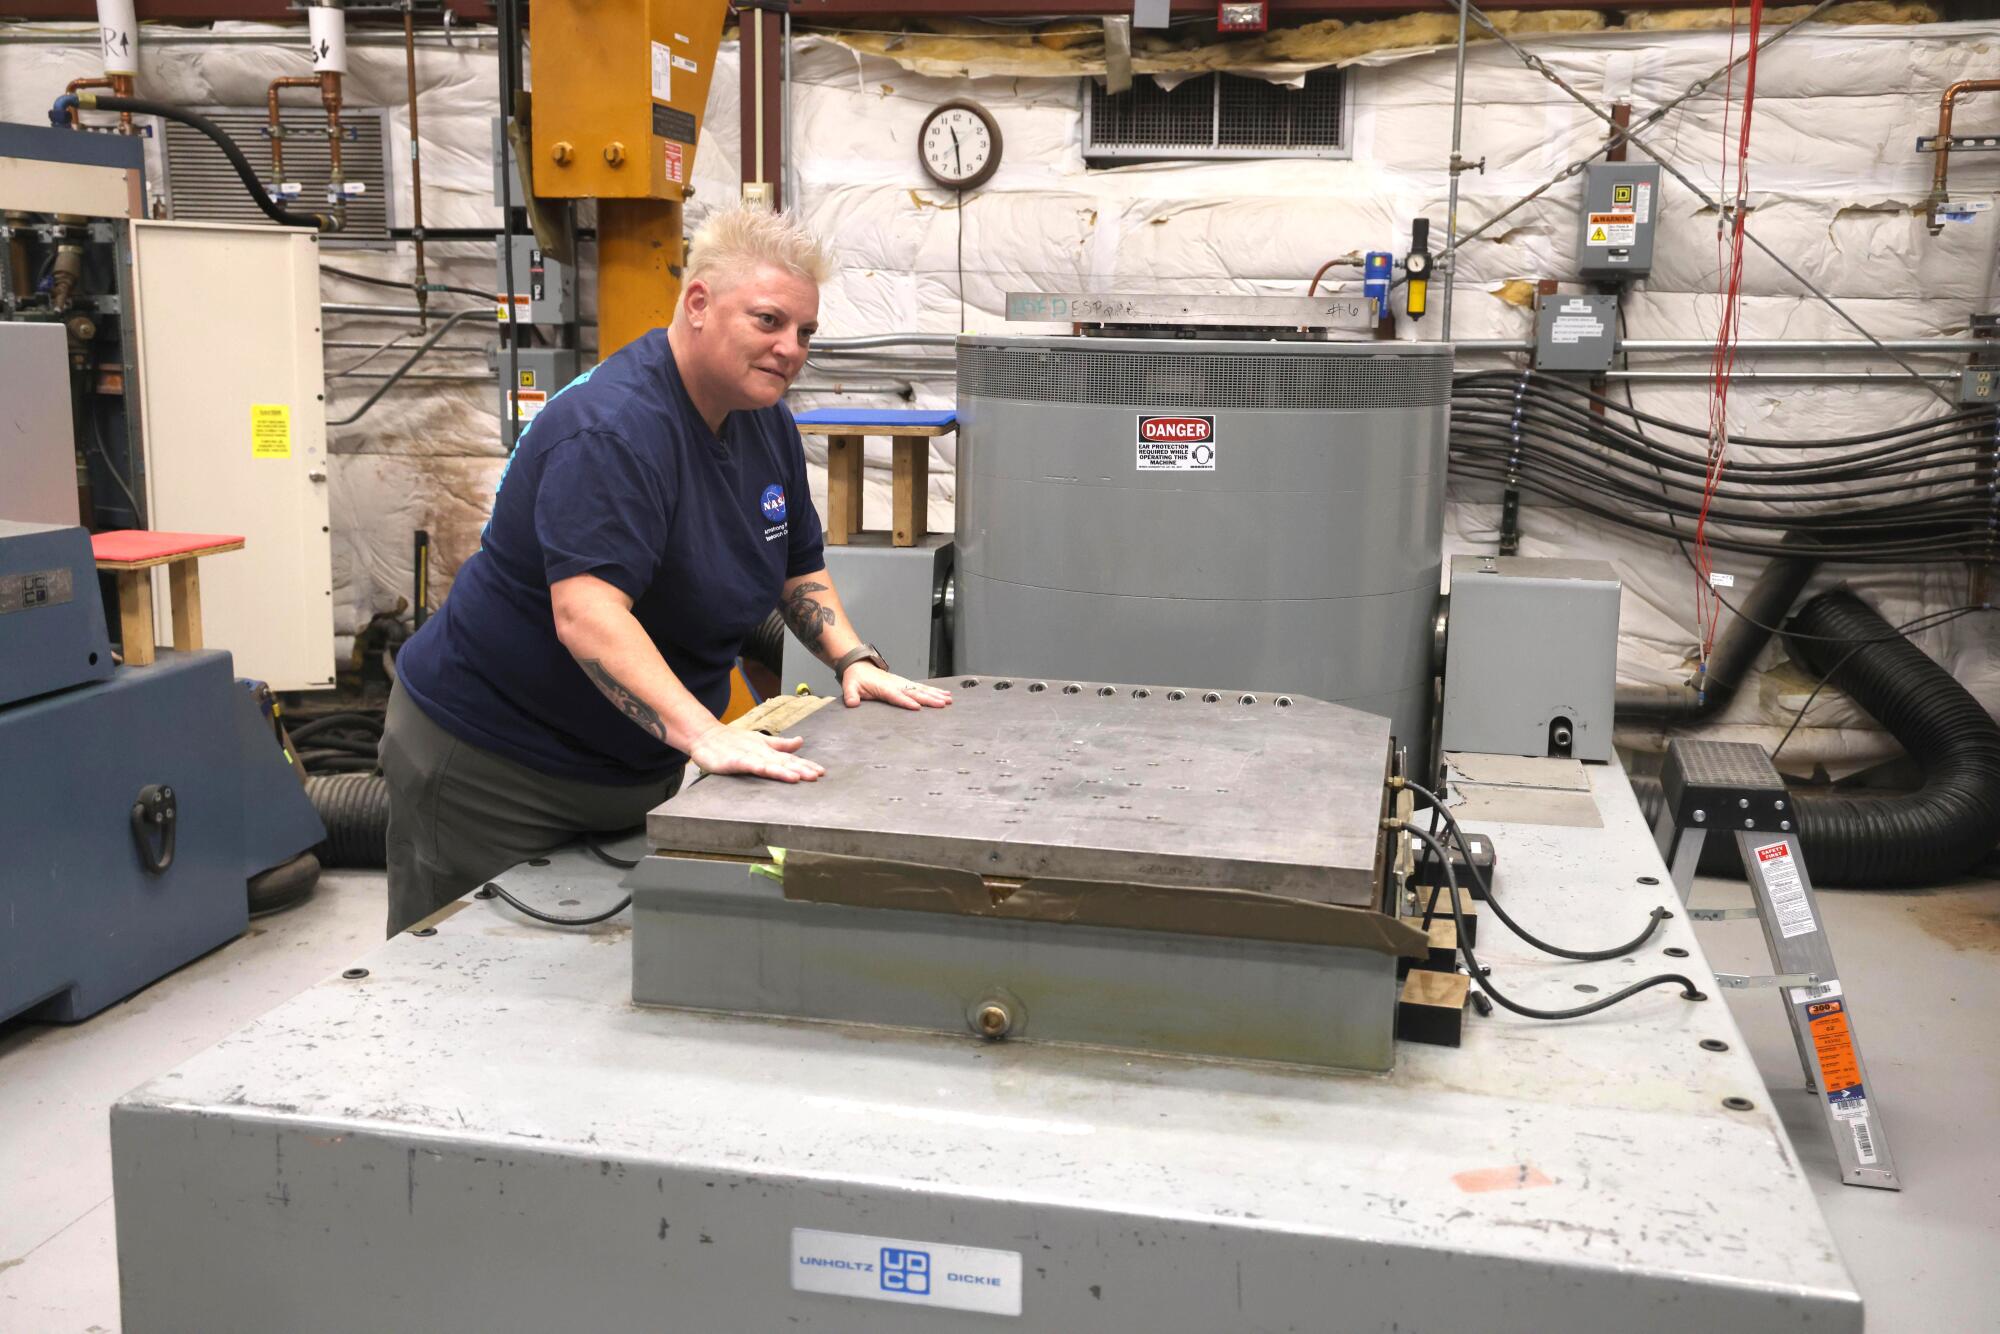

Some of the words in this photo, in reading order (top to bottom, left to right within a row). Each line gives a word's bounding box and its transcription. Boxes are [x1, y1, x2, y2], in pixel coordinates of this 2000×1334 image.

[103, 27, 120, 58] R
[1146, 423, 1206, 437] DANGER
[763, 496, 785, 511] NAS
[1761, 846, 1783, 856] SAFETY
[800, 1256, 874, 1272] UNHOLTZ
[947, 1273, 1001, 1287] DICKIE
